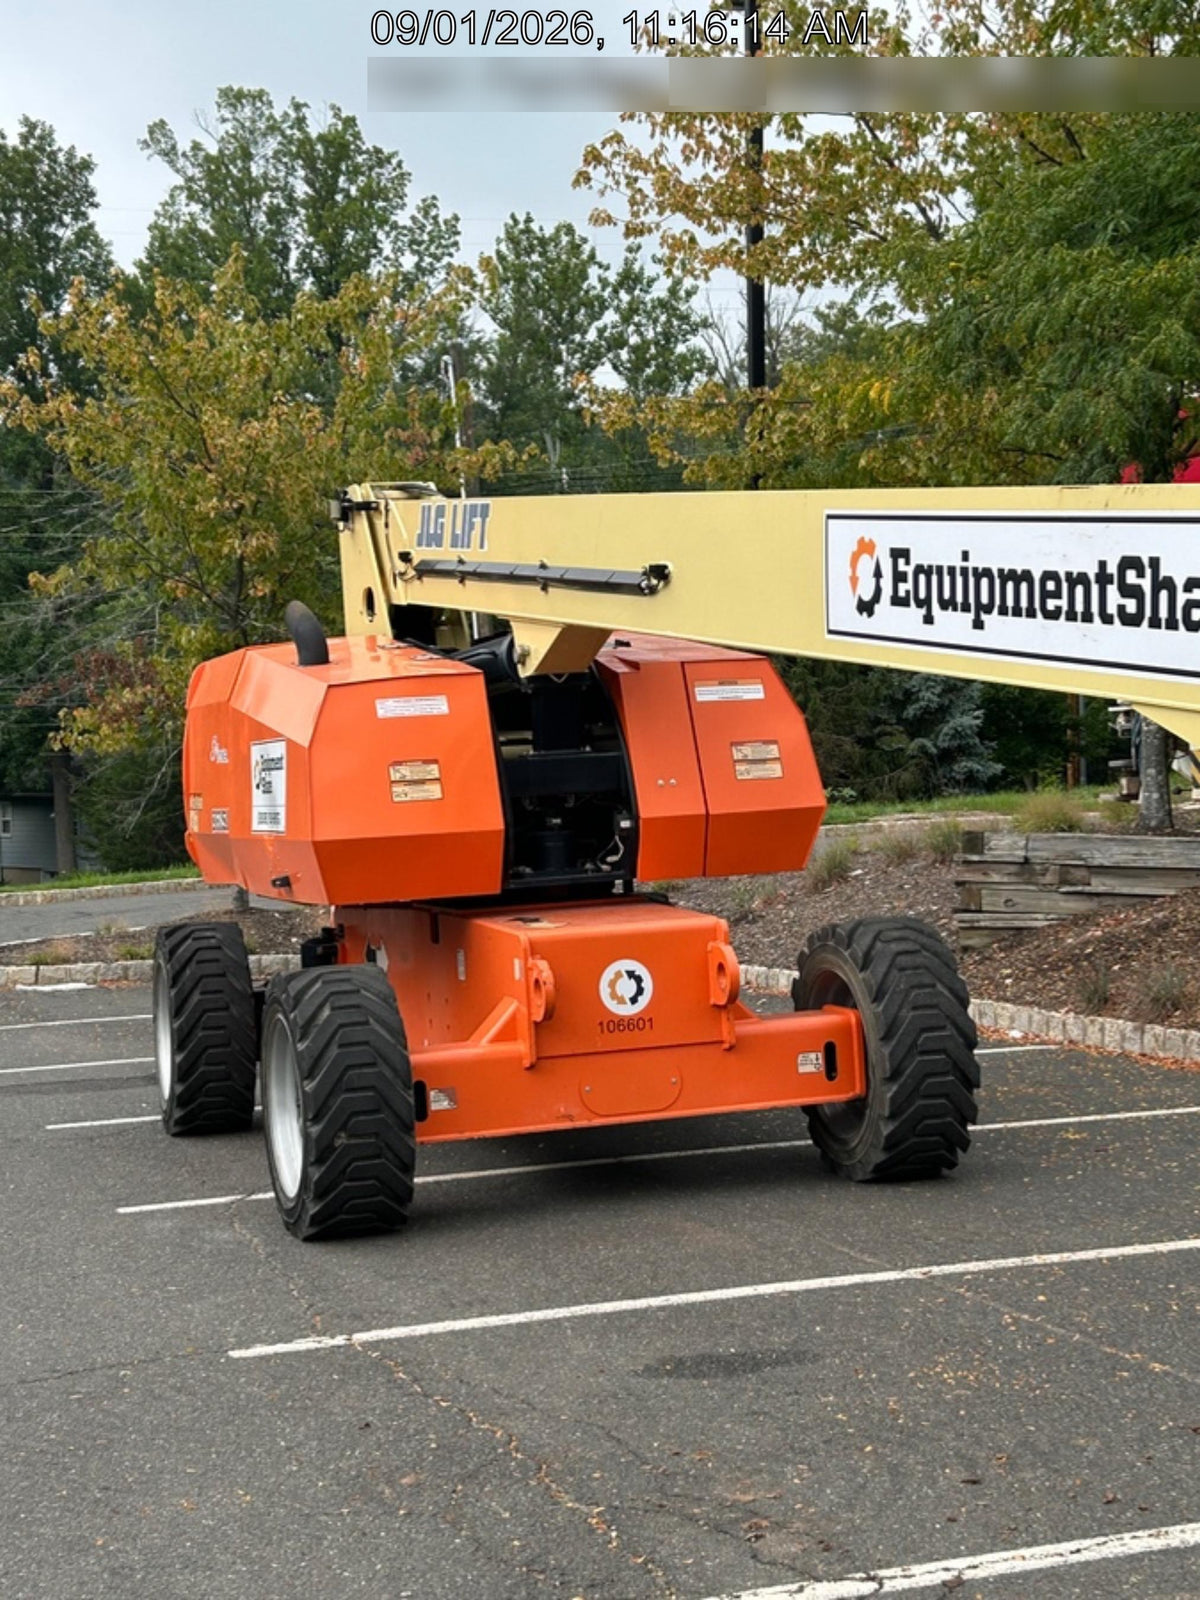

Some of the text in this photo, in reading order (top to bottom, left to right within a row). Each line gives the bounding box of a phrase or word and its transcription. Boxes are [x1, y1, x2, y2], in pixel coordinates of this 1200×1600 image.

[416, 501, 491, 551] JLG LIFT
[598, 1016, 653, 1034] 106601
